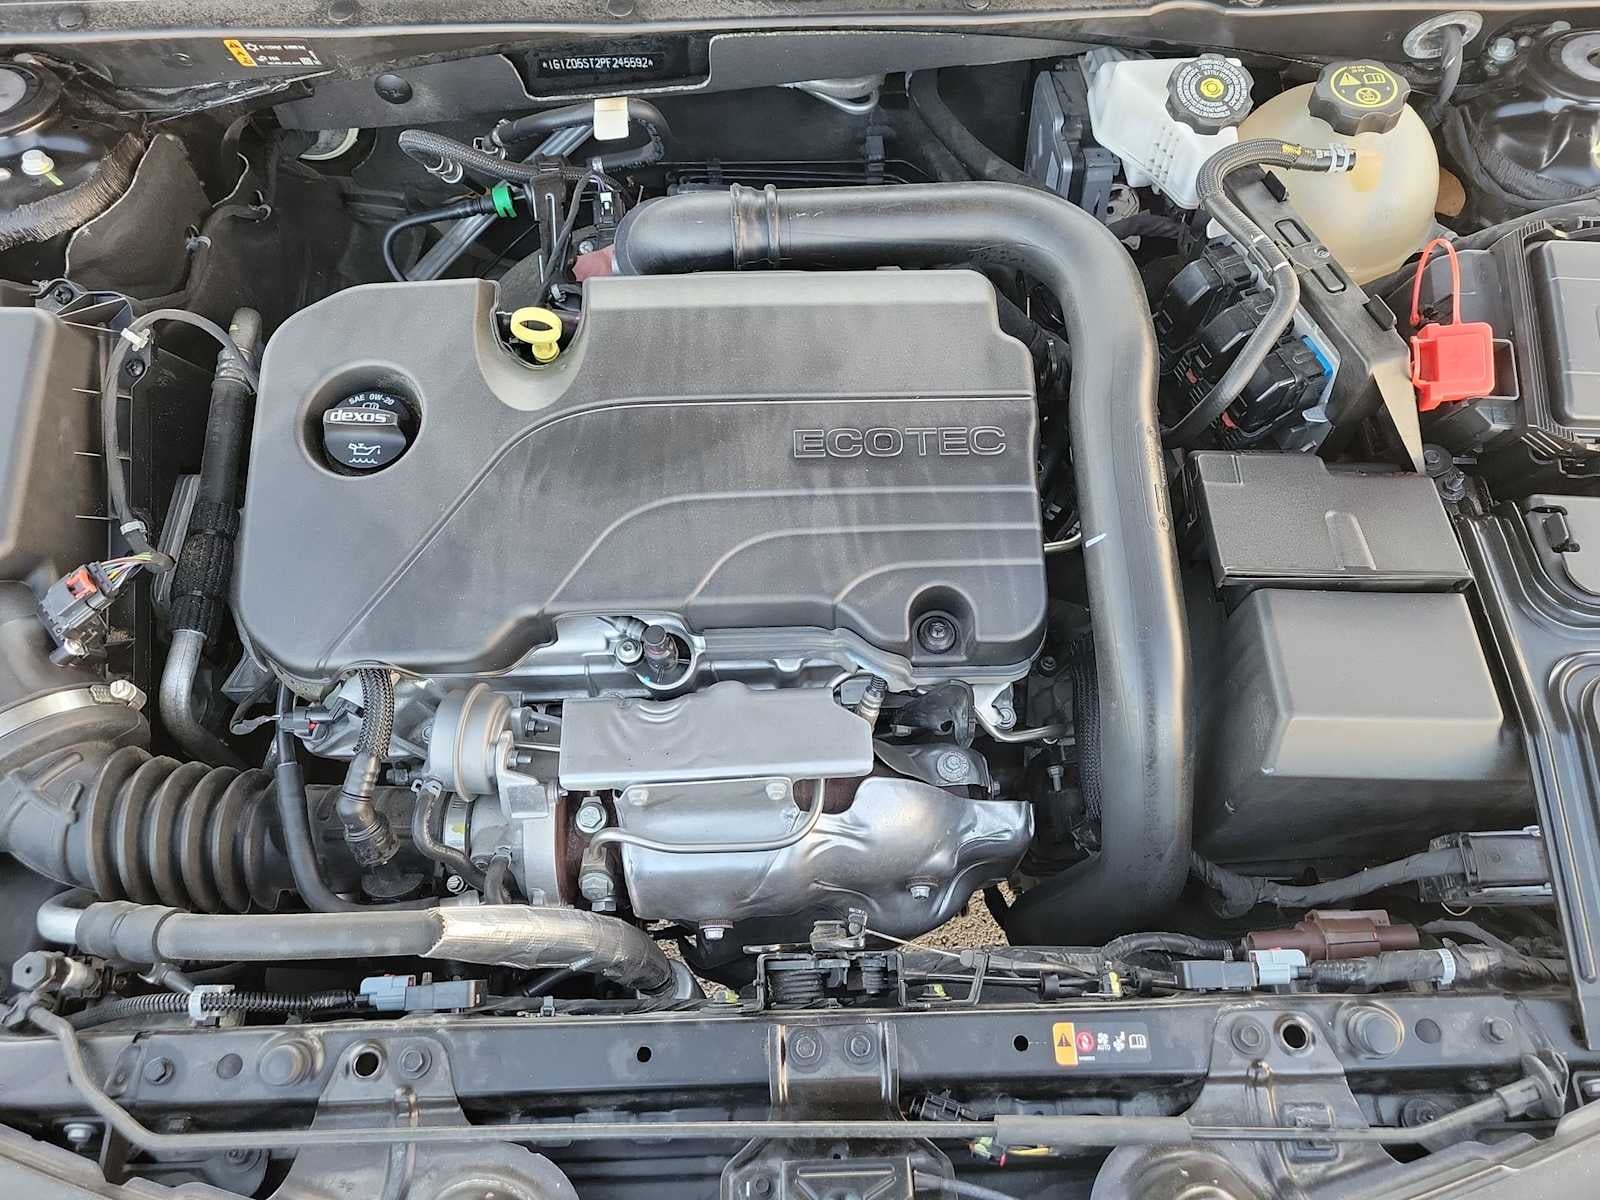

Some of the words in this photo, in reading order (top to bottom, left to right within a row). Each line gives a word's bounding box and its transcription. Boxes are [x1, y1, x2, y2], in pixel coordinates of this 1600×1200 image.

[348, 394, 365, 405] SAE
[369, 393, 395, 406] 0W-20
[330, 409, 390, 423] dexos
[793, 426, 1007, 458] ECOTEC
